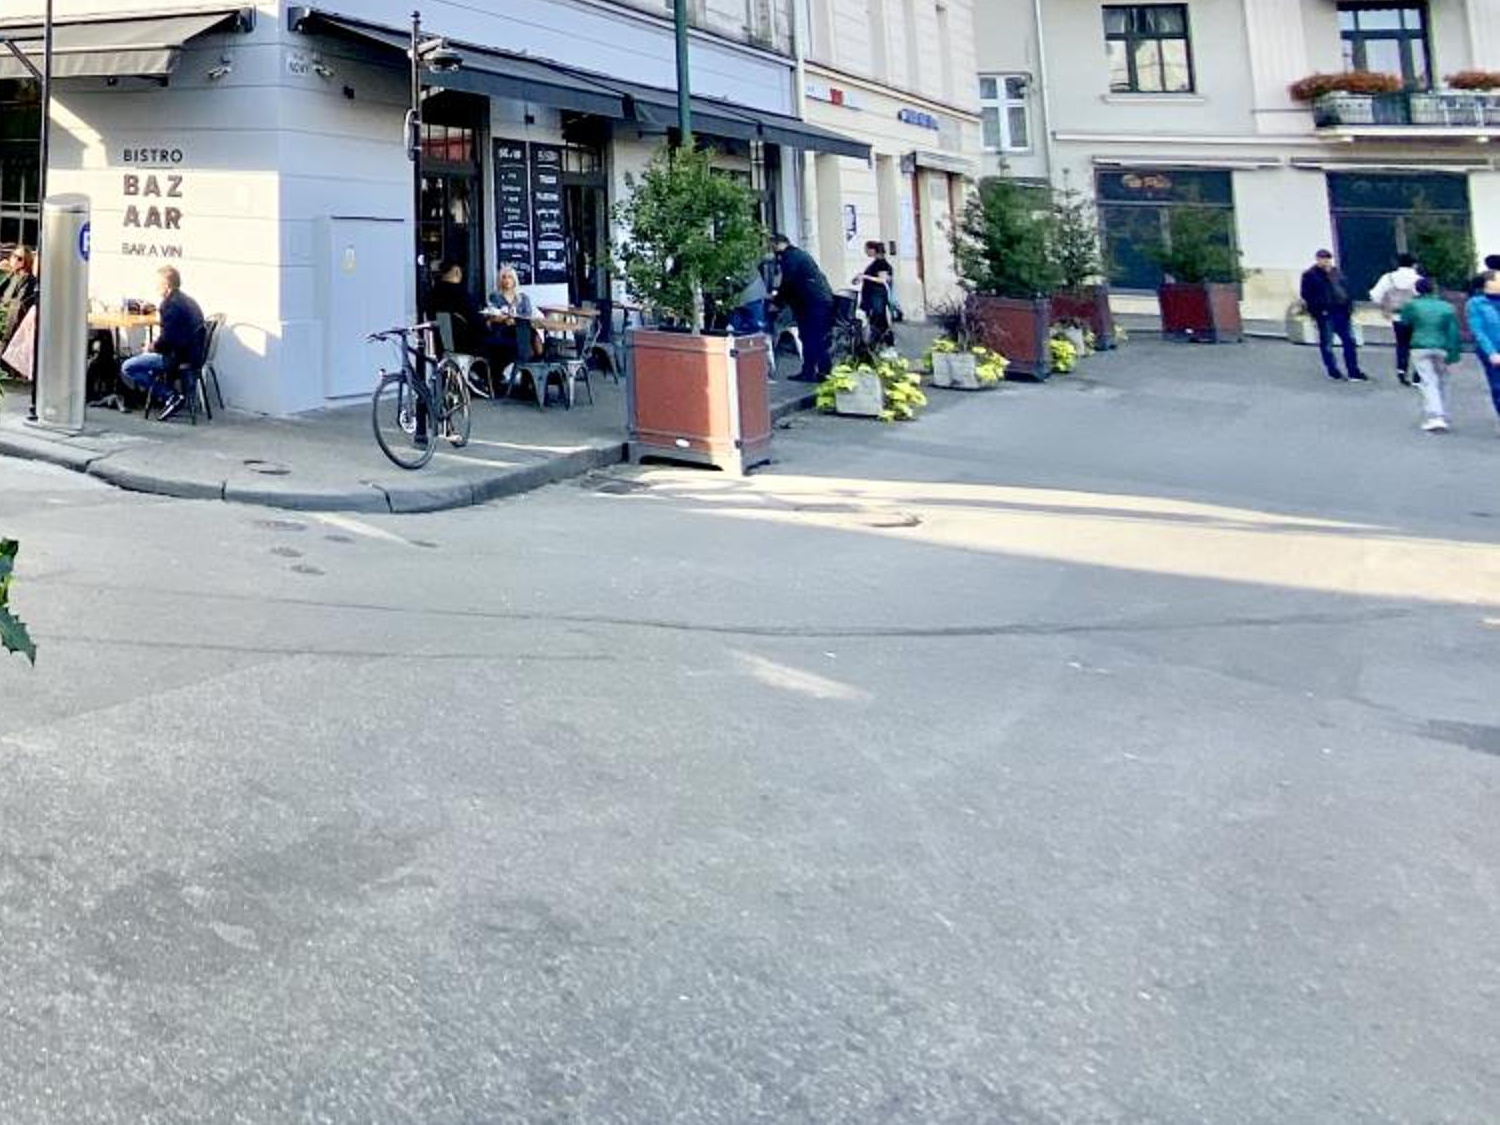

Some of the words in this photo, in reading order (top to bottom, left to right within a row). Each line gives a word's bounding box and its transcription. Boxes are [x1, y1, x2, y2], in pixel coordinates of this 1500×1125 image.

[123, 148, 183, 164] BISTRO
[123, 174, 183, 198] BAZ
[123, 205, 184, 229] AAR
[121, 243, 146, 255] BAR
[148, 244, 159, 257] A
[160, 245, 183, 258] VIN
